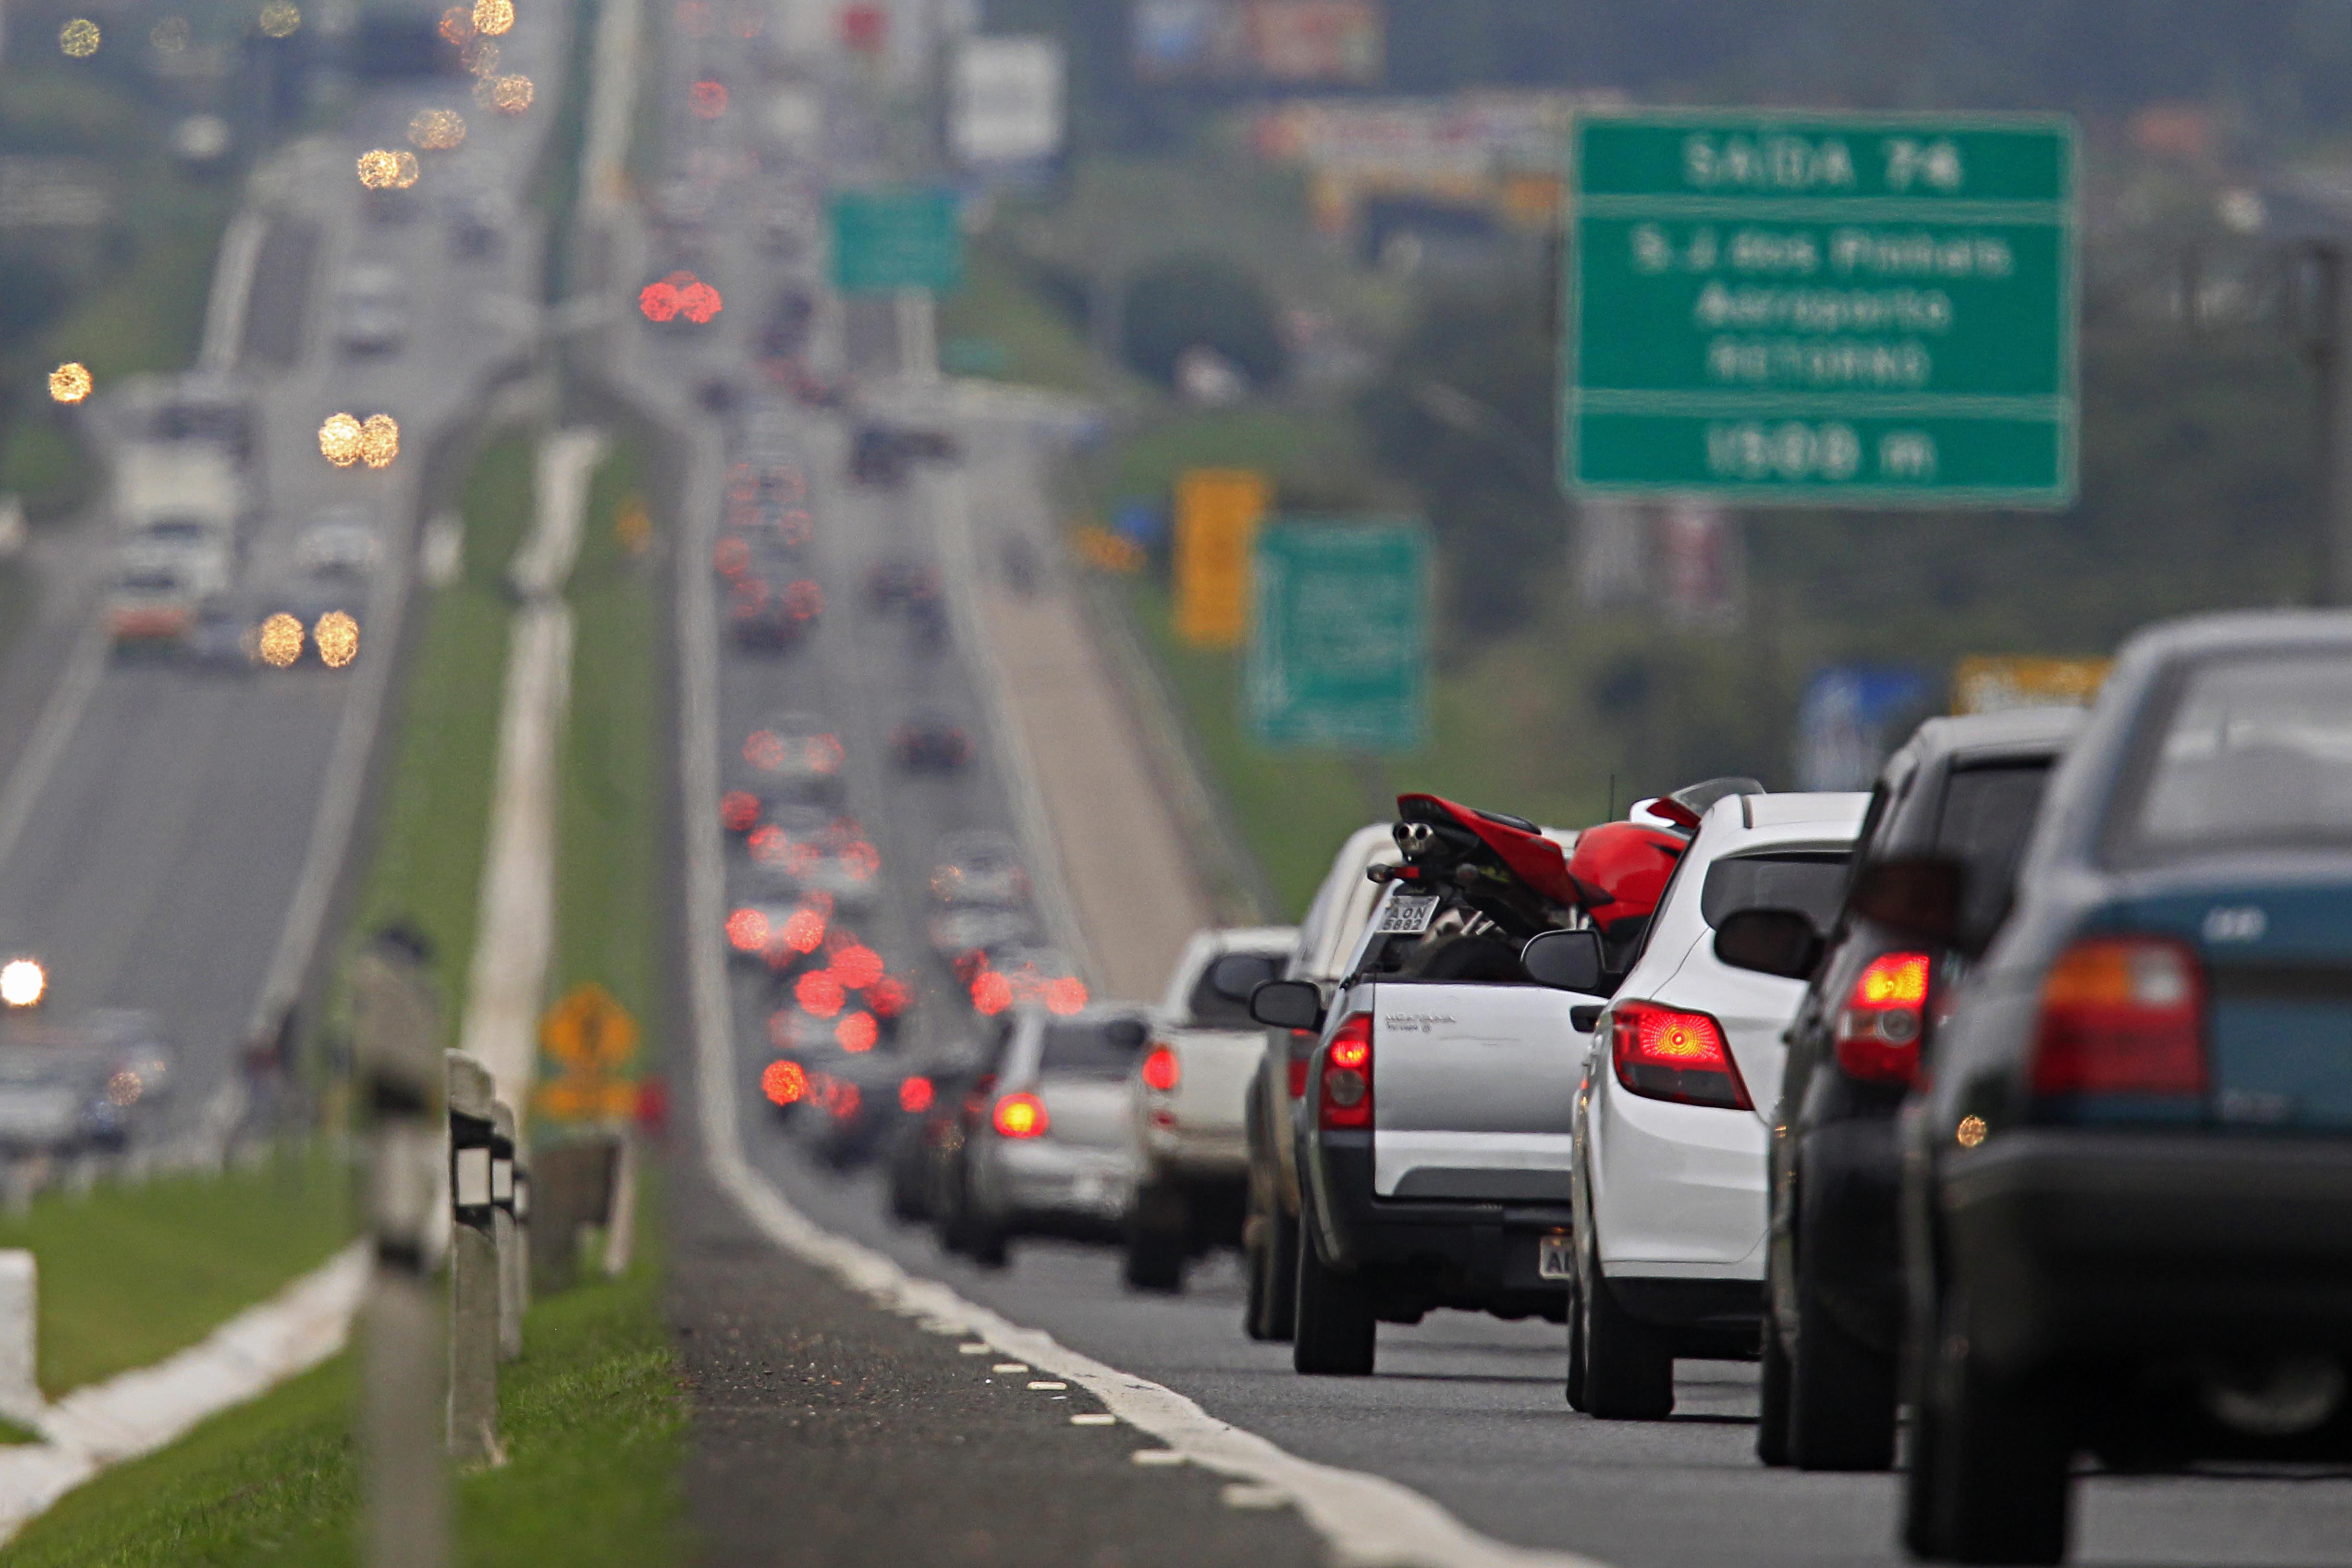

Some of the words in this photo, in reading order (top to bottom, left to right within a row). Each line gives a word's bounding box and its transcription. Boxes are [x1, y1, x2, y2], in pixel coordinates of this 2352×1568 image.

[1884, 138, 1962, 188] 74
[1696, 282, 1950, 331] Aeroporto
[1708, 337, 1929, 380] RETORNO
[1708, 423, 1860, 478] 1500
[1879, 433, 1936, 477] m
